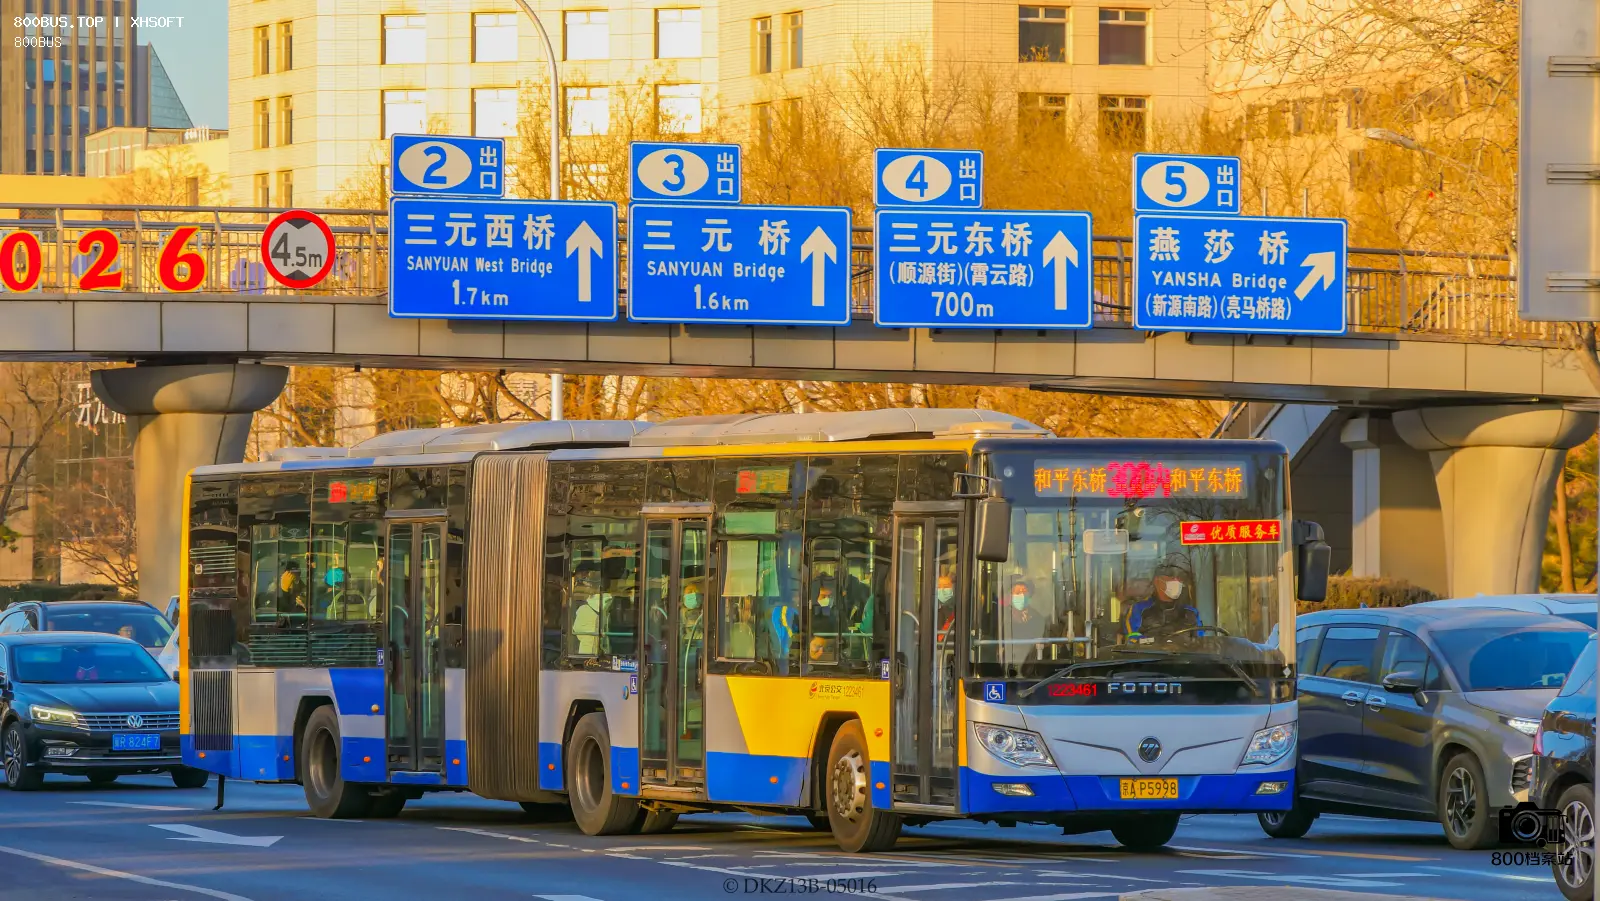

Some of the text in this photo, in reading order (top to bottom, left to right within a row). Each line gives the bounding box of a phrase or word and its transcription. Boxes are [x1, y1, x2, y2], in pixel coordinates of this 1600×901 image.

[422, 145, 448, 185] 2
[479, 145, 498, 190] 出口
[662, 153, 686, 192] 3
[716, 152, 735, 196] 出口
[905, 159, 929, 198] 4
[958, 158, 977, 201] 出口
[1164, 165, 1188, 203] 5
[1216, 164, 1234, 207] 出口
[271, 232, 323, 268] 4.5m
[404, 212, 555, 251] 三元西桥
[643, 218, 791, 256] 三元桥
[889, 221, 1033, 258] 三元东桥
[1149, 226, 1290, 266] 燕莎桥
[406, 255, 553, 278] SANYUAN West Bridge
[647, 260, 786, 282] SANYUAN Bridge
[1151, 270, 1288, 293] YANSHA Bridge
[931, 291, 994, 317] 700m
[1034, 467, 1107, 493] 和平东桥
[1170, 467, 1243, 493] 和平东桥
[1210, 523, 1279, 541] 优质服务车
[1047, 683, 1098, 697] 1223461
